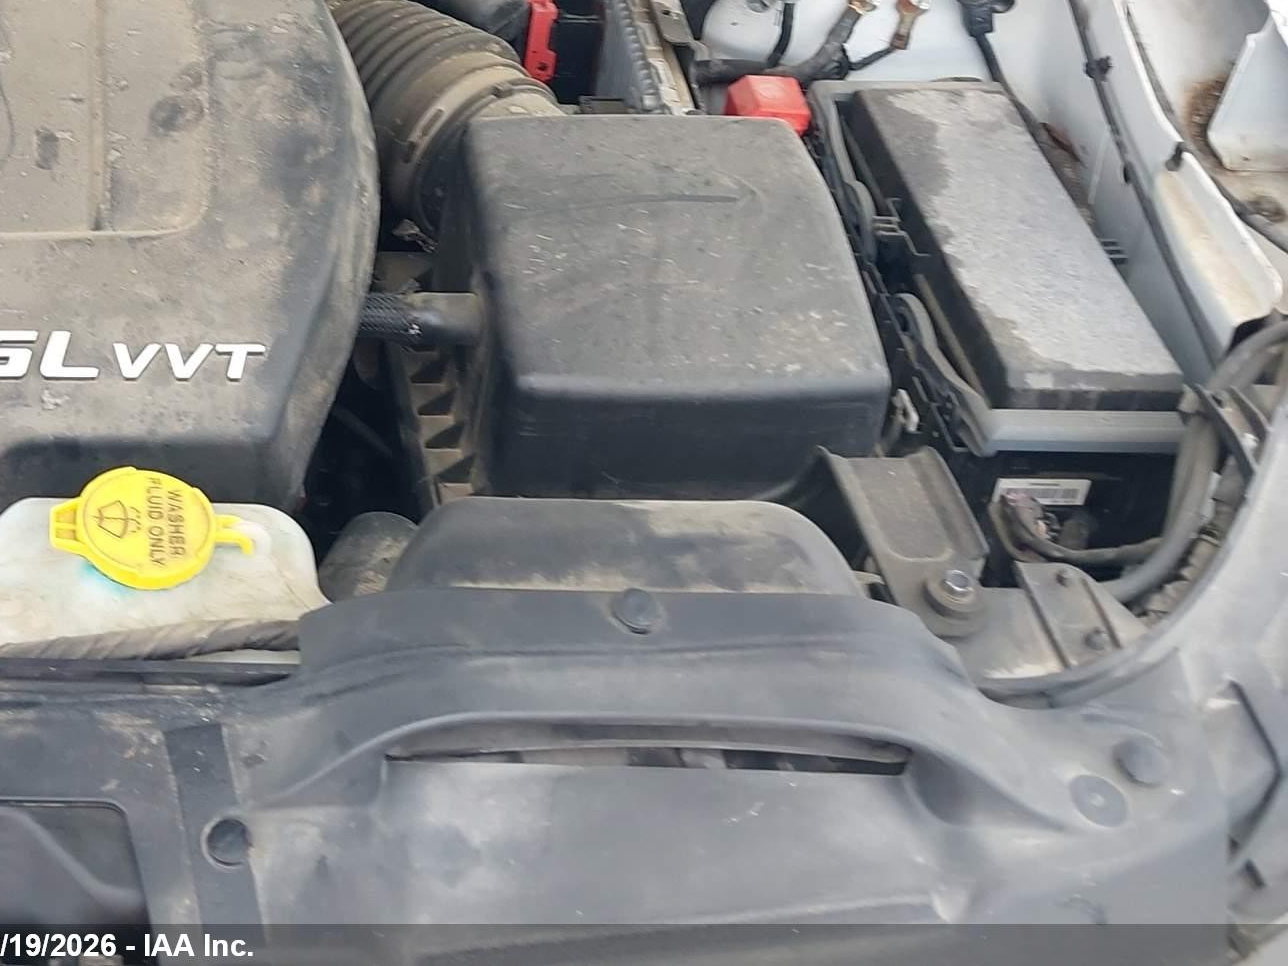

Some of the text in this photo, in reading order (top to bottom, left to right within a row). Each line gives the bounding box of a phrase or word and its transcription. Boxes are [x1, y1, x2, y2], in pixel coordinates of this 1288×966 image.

[112, 342, 266, 380] VVT
[147, 478, 165, 568] FLUID ONLY
[167, 489, 185, 558] WASHER
